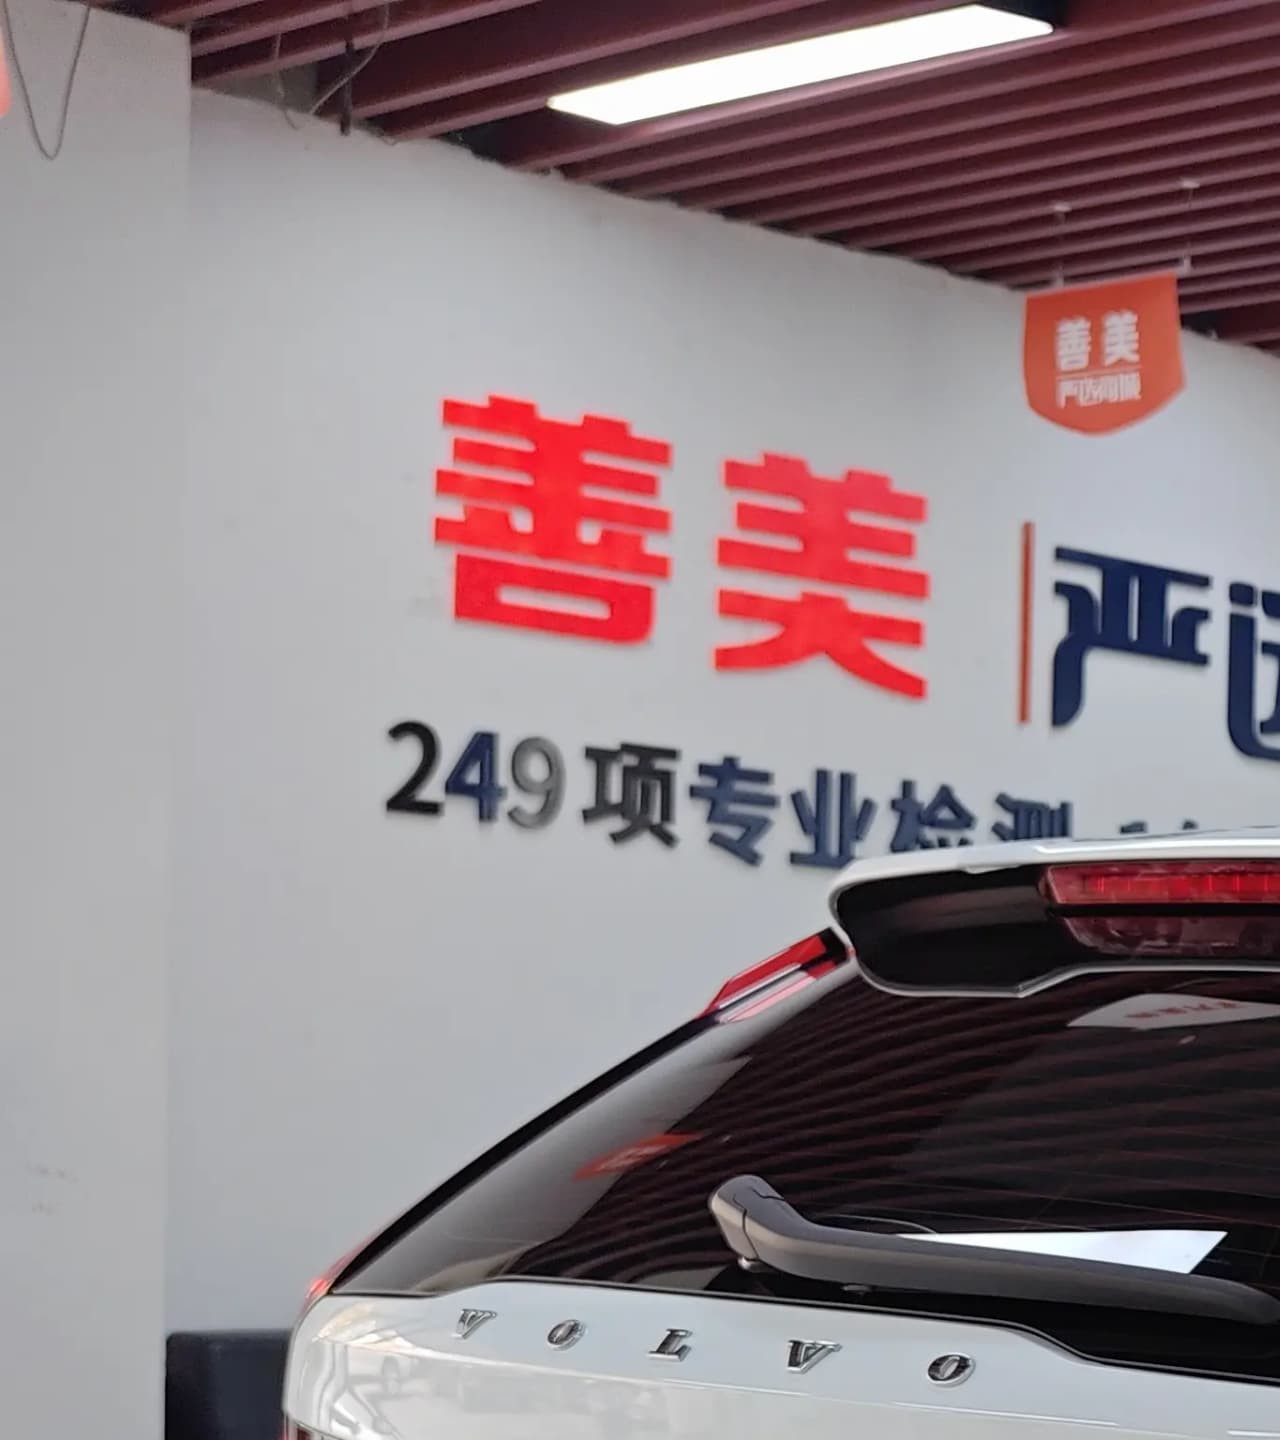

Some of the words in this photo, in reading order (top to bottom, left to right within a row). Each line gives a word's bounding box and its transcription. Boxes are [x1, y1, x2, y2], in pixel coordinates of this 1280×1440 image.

[1056, 308, 1140, 372] 善美
[434, 394, 930, 700] 善美
[458, 1308, 976, 1386] VOLVO
